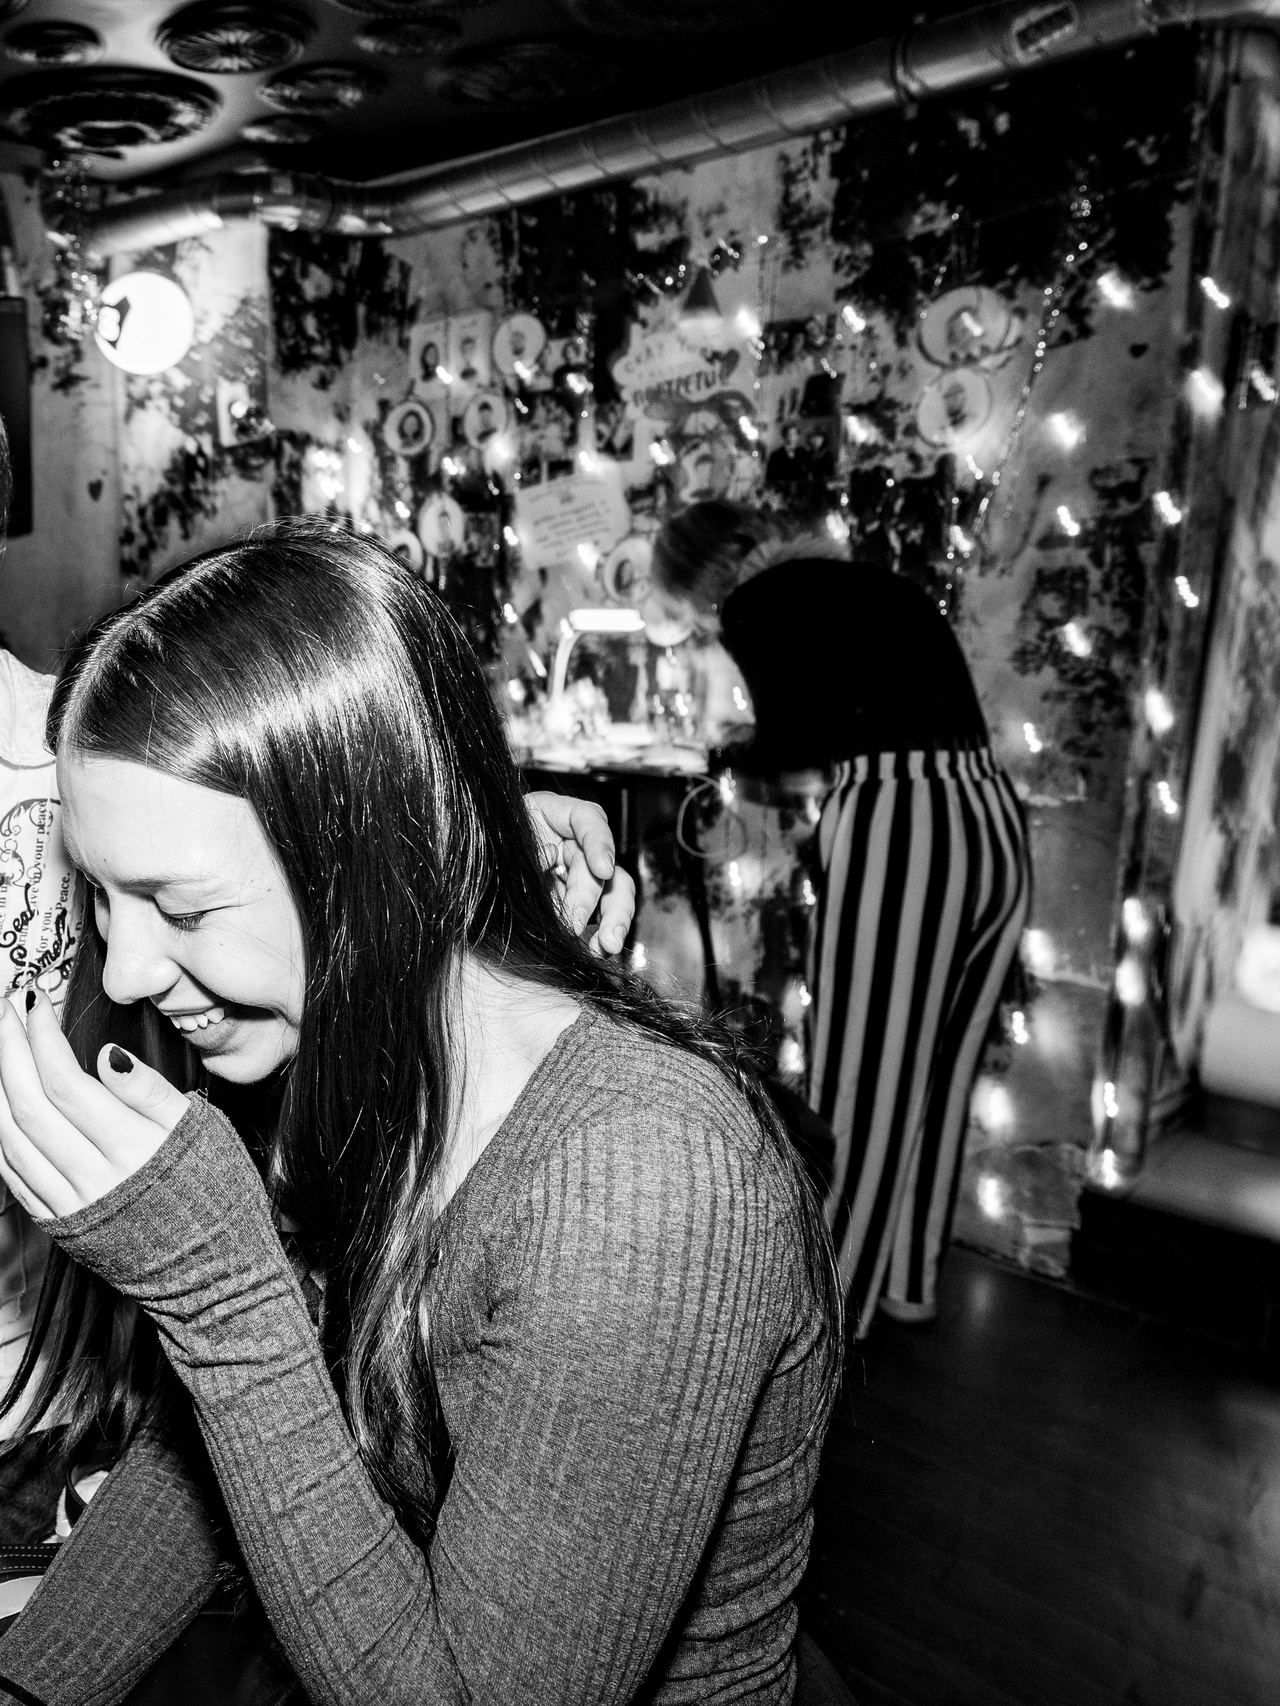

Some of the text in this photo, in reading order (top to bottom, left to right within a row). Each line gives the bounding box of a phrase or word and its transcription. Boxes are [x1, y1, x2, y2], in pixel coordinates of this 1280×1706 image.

[32, 838, 47, 868] your
[55, 871, 70, 911] Peace.
[36, 906, 54, 954] for you.
